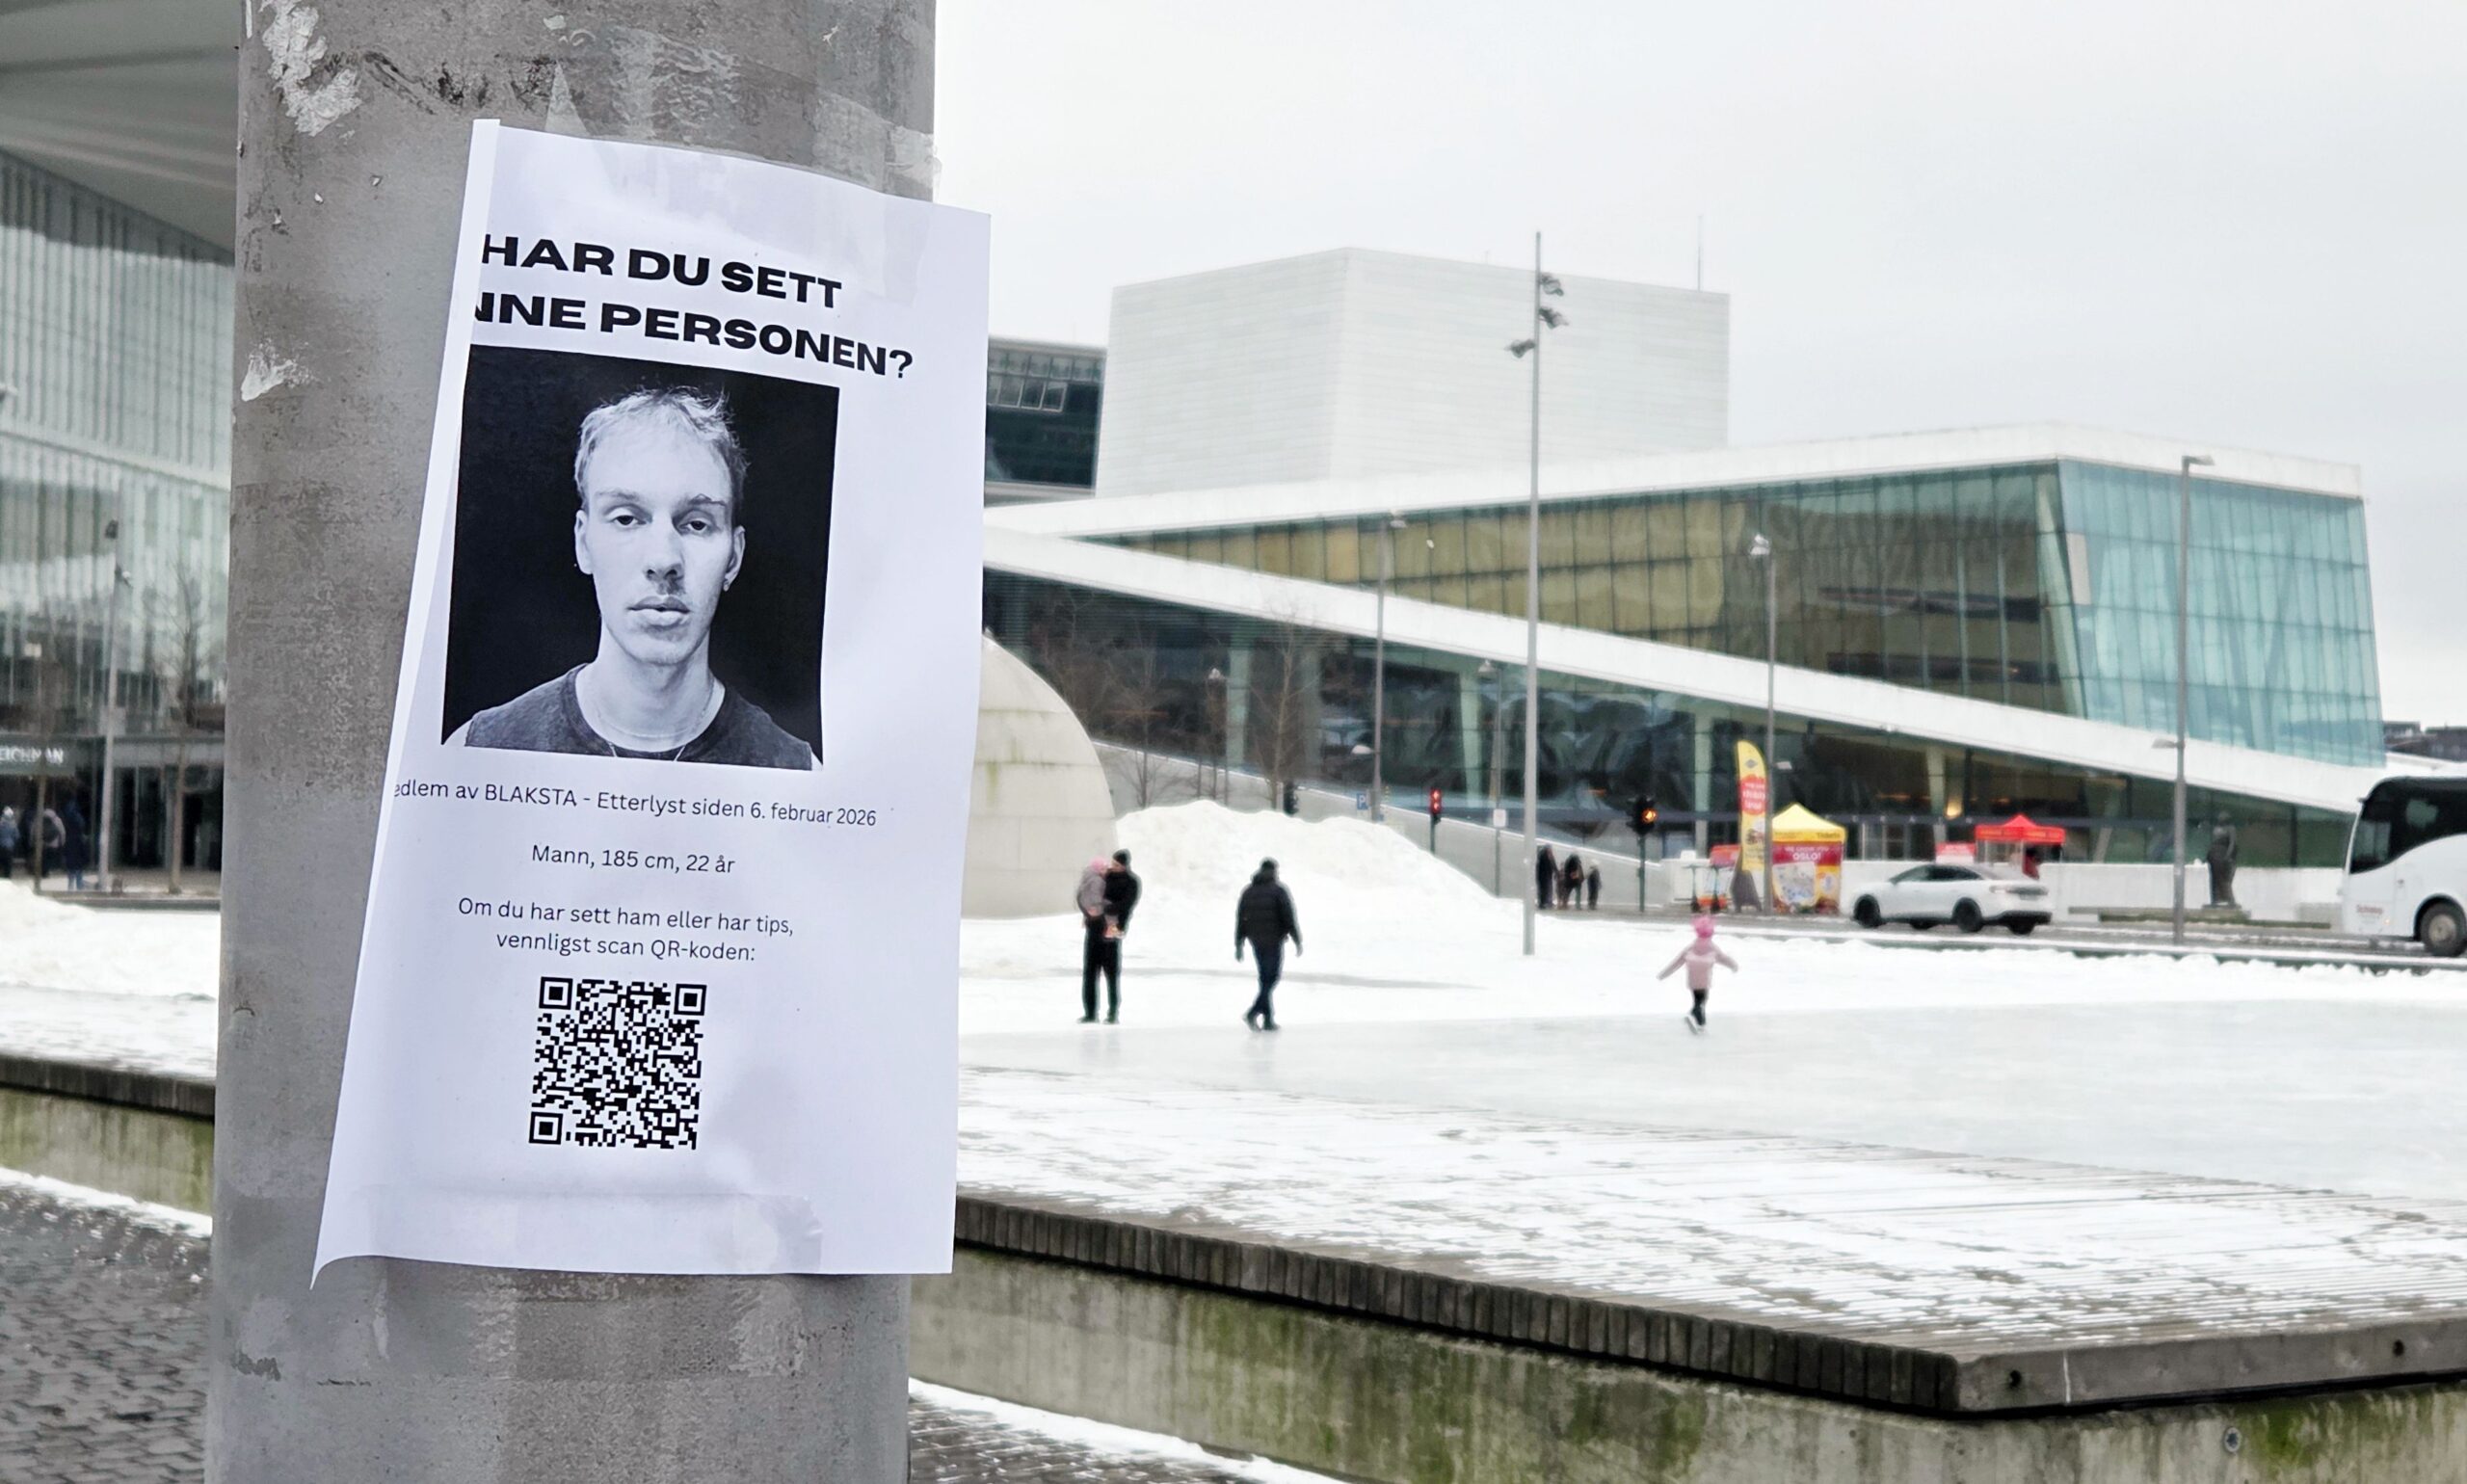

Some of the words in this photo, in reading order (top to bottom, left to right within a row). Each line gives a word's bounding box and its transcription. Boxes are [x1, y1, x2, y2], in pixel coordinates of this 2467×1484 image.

[481, 233, 615, 277] HAR
[627, 248, 710, 286] DU
[721, 261, 842, 308] SETT
[598, 301, 914, 380] PERSONEN?
[455, 784, 479, 800] av
[485, 783, 577, 808] BLAKSTA
[597, 791, 686, 817] Etterlyst
[691, 798, 744, 817] siden
[750, 802, 765, 819] 6.
[771, 802, 834, 823] februar
[836, 808, 876, 827] 2026
[532, 844, 595, 869] Mann,
[601, 849, 639, 868] 185
[644, 855, 680, 874] cm,
[685, 854, 710, 872] 22
[714, 854, 735, 873] år
[458, 897, 492, 916] Om
[497, 900, 523, 919] du
[530, 901, 566, 921] har
[570, 907, 611, 924] sett
[617, 907, 660, 927] ham
[666, 910, 713, 929] eller
[717, 913, 752, 931] har
[756, 914, 793, 937] tips,
[496, 932, 592, 957] vennligst
[597, 940, 644, 956] scan
[650, 939, 756, 962] QR-koden:
